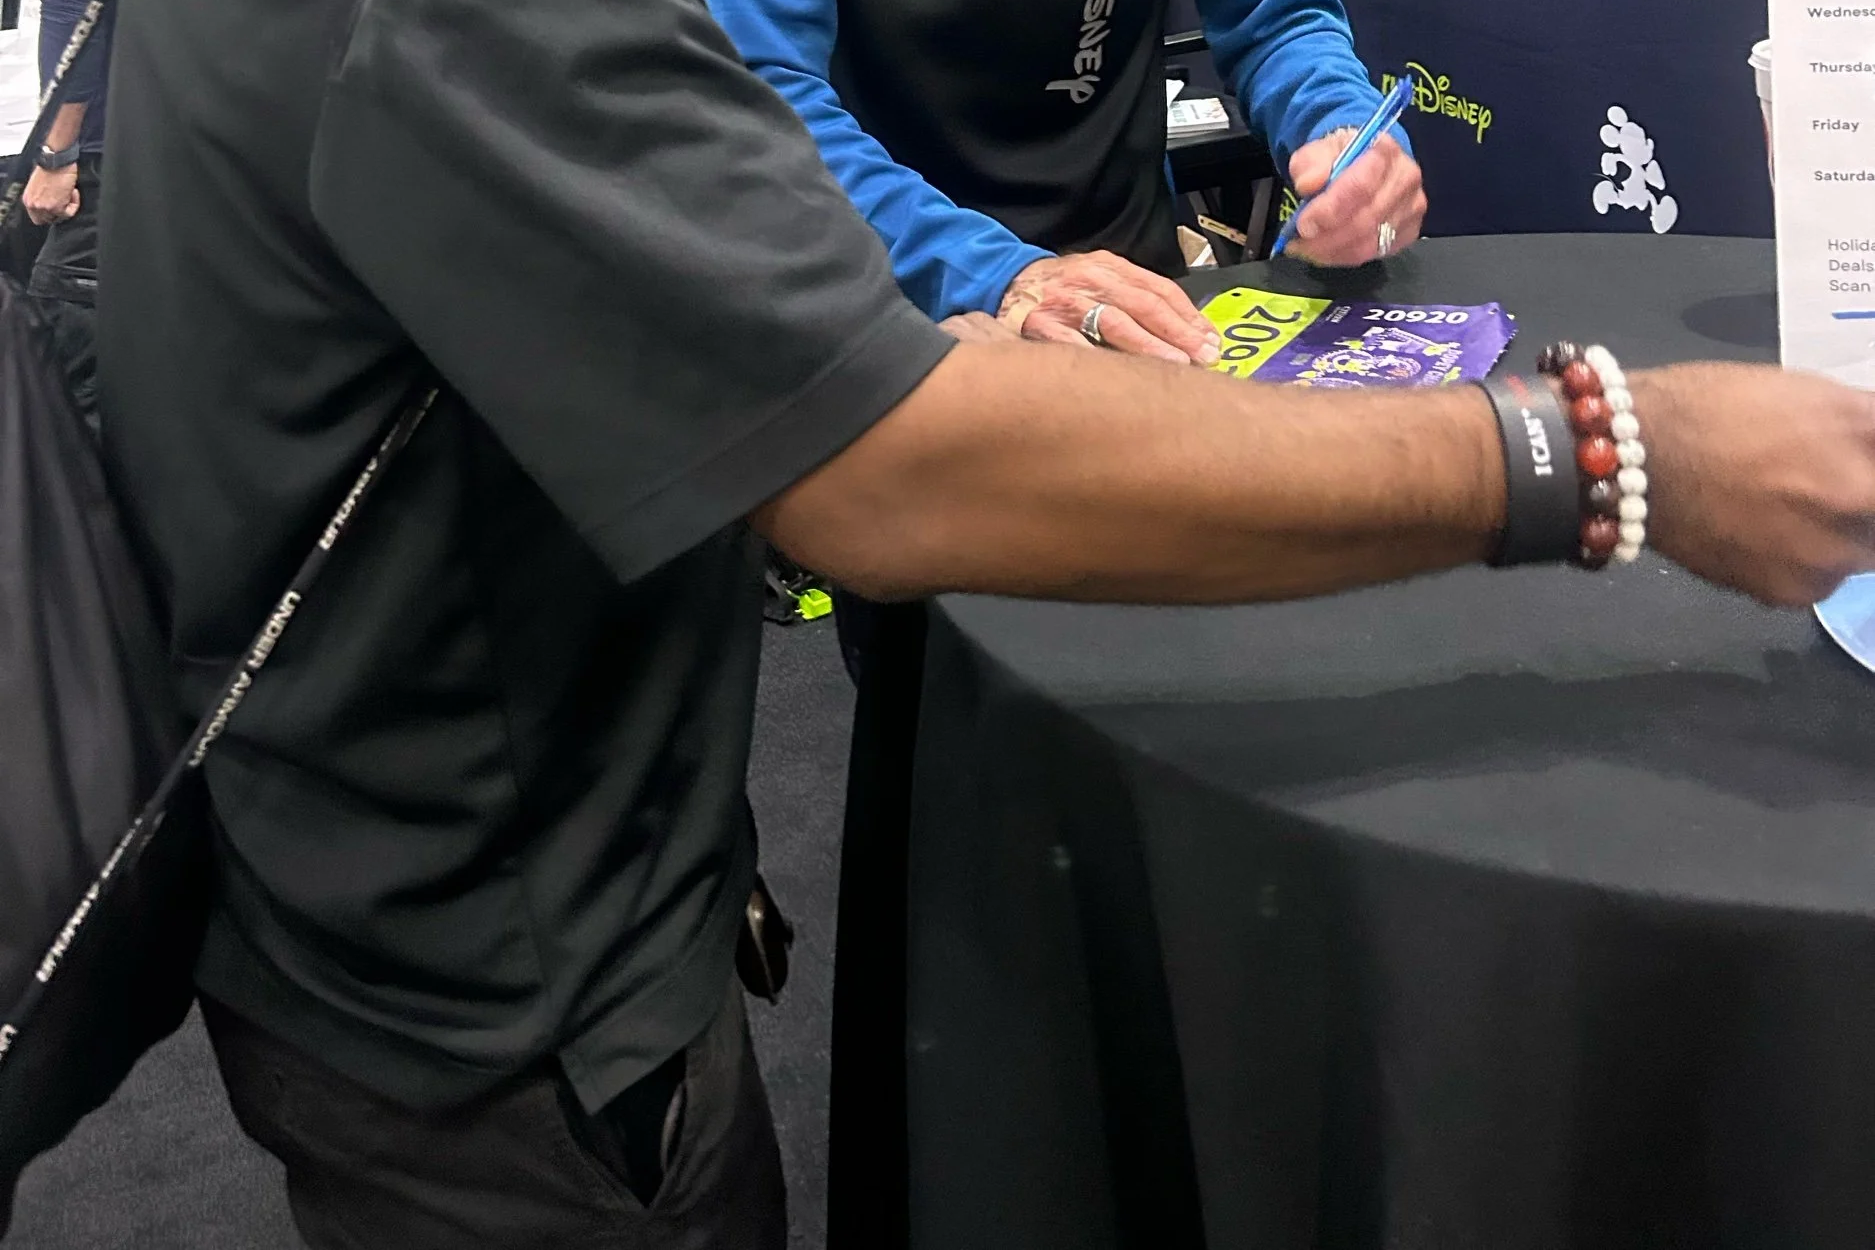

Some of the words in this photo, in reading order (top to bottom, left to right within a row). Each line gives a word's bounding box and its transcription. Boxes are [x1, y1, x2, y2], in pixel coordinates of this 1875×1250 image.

[1812, 119, 1860, 132] Friday
[1829, 279, 1871, 292] Scan
[1362, 308, 1469, 325] 20920
[247, 590, 302, 670] UNDER
